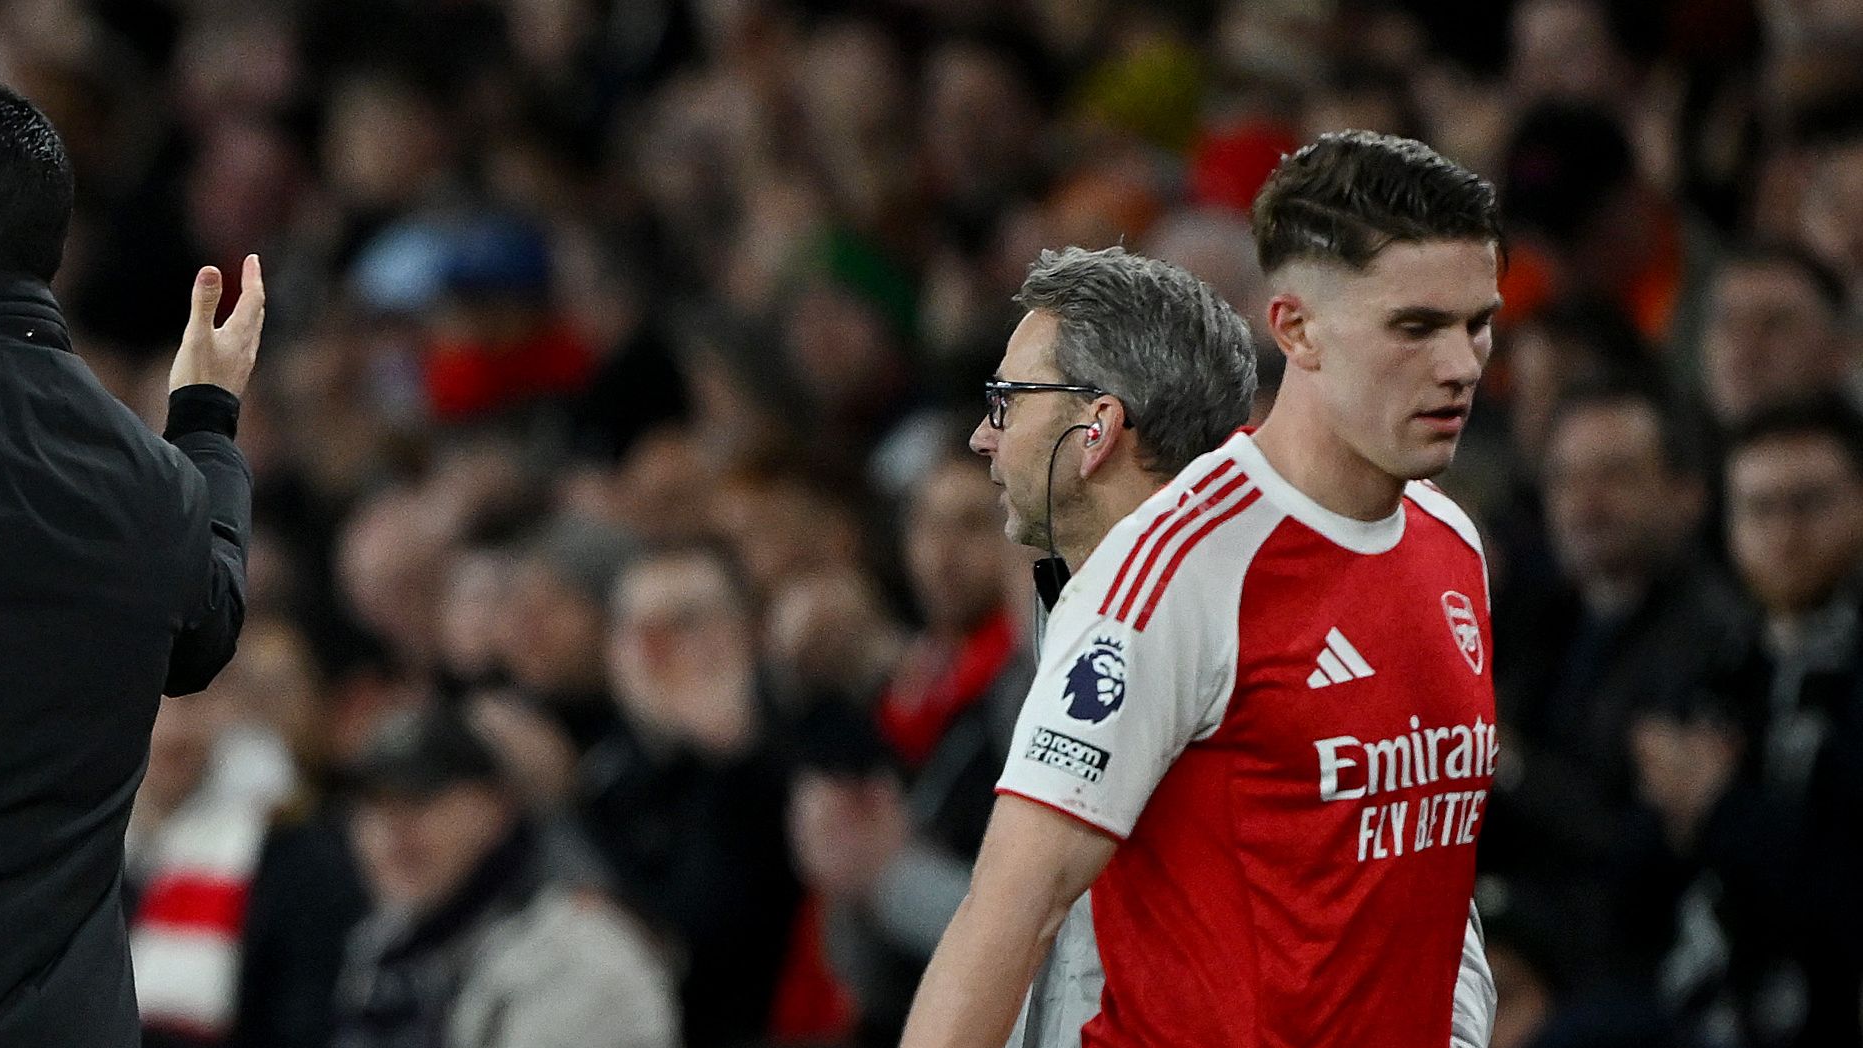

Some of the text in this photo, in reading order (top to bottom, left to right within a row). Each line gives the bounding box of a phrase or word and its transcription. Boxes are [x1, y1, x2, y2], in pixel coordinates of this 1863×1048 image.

[1050, 735, 1102, 766] room
[1313, 714, 1499, 802] Emirate
[1357, 789, 1487, 862] FLY BETTE
